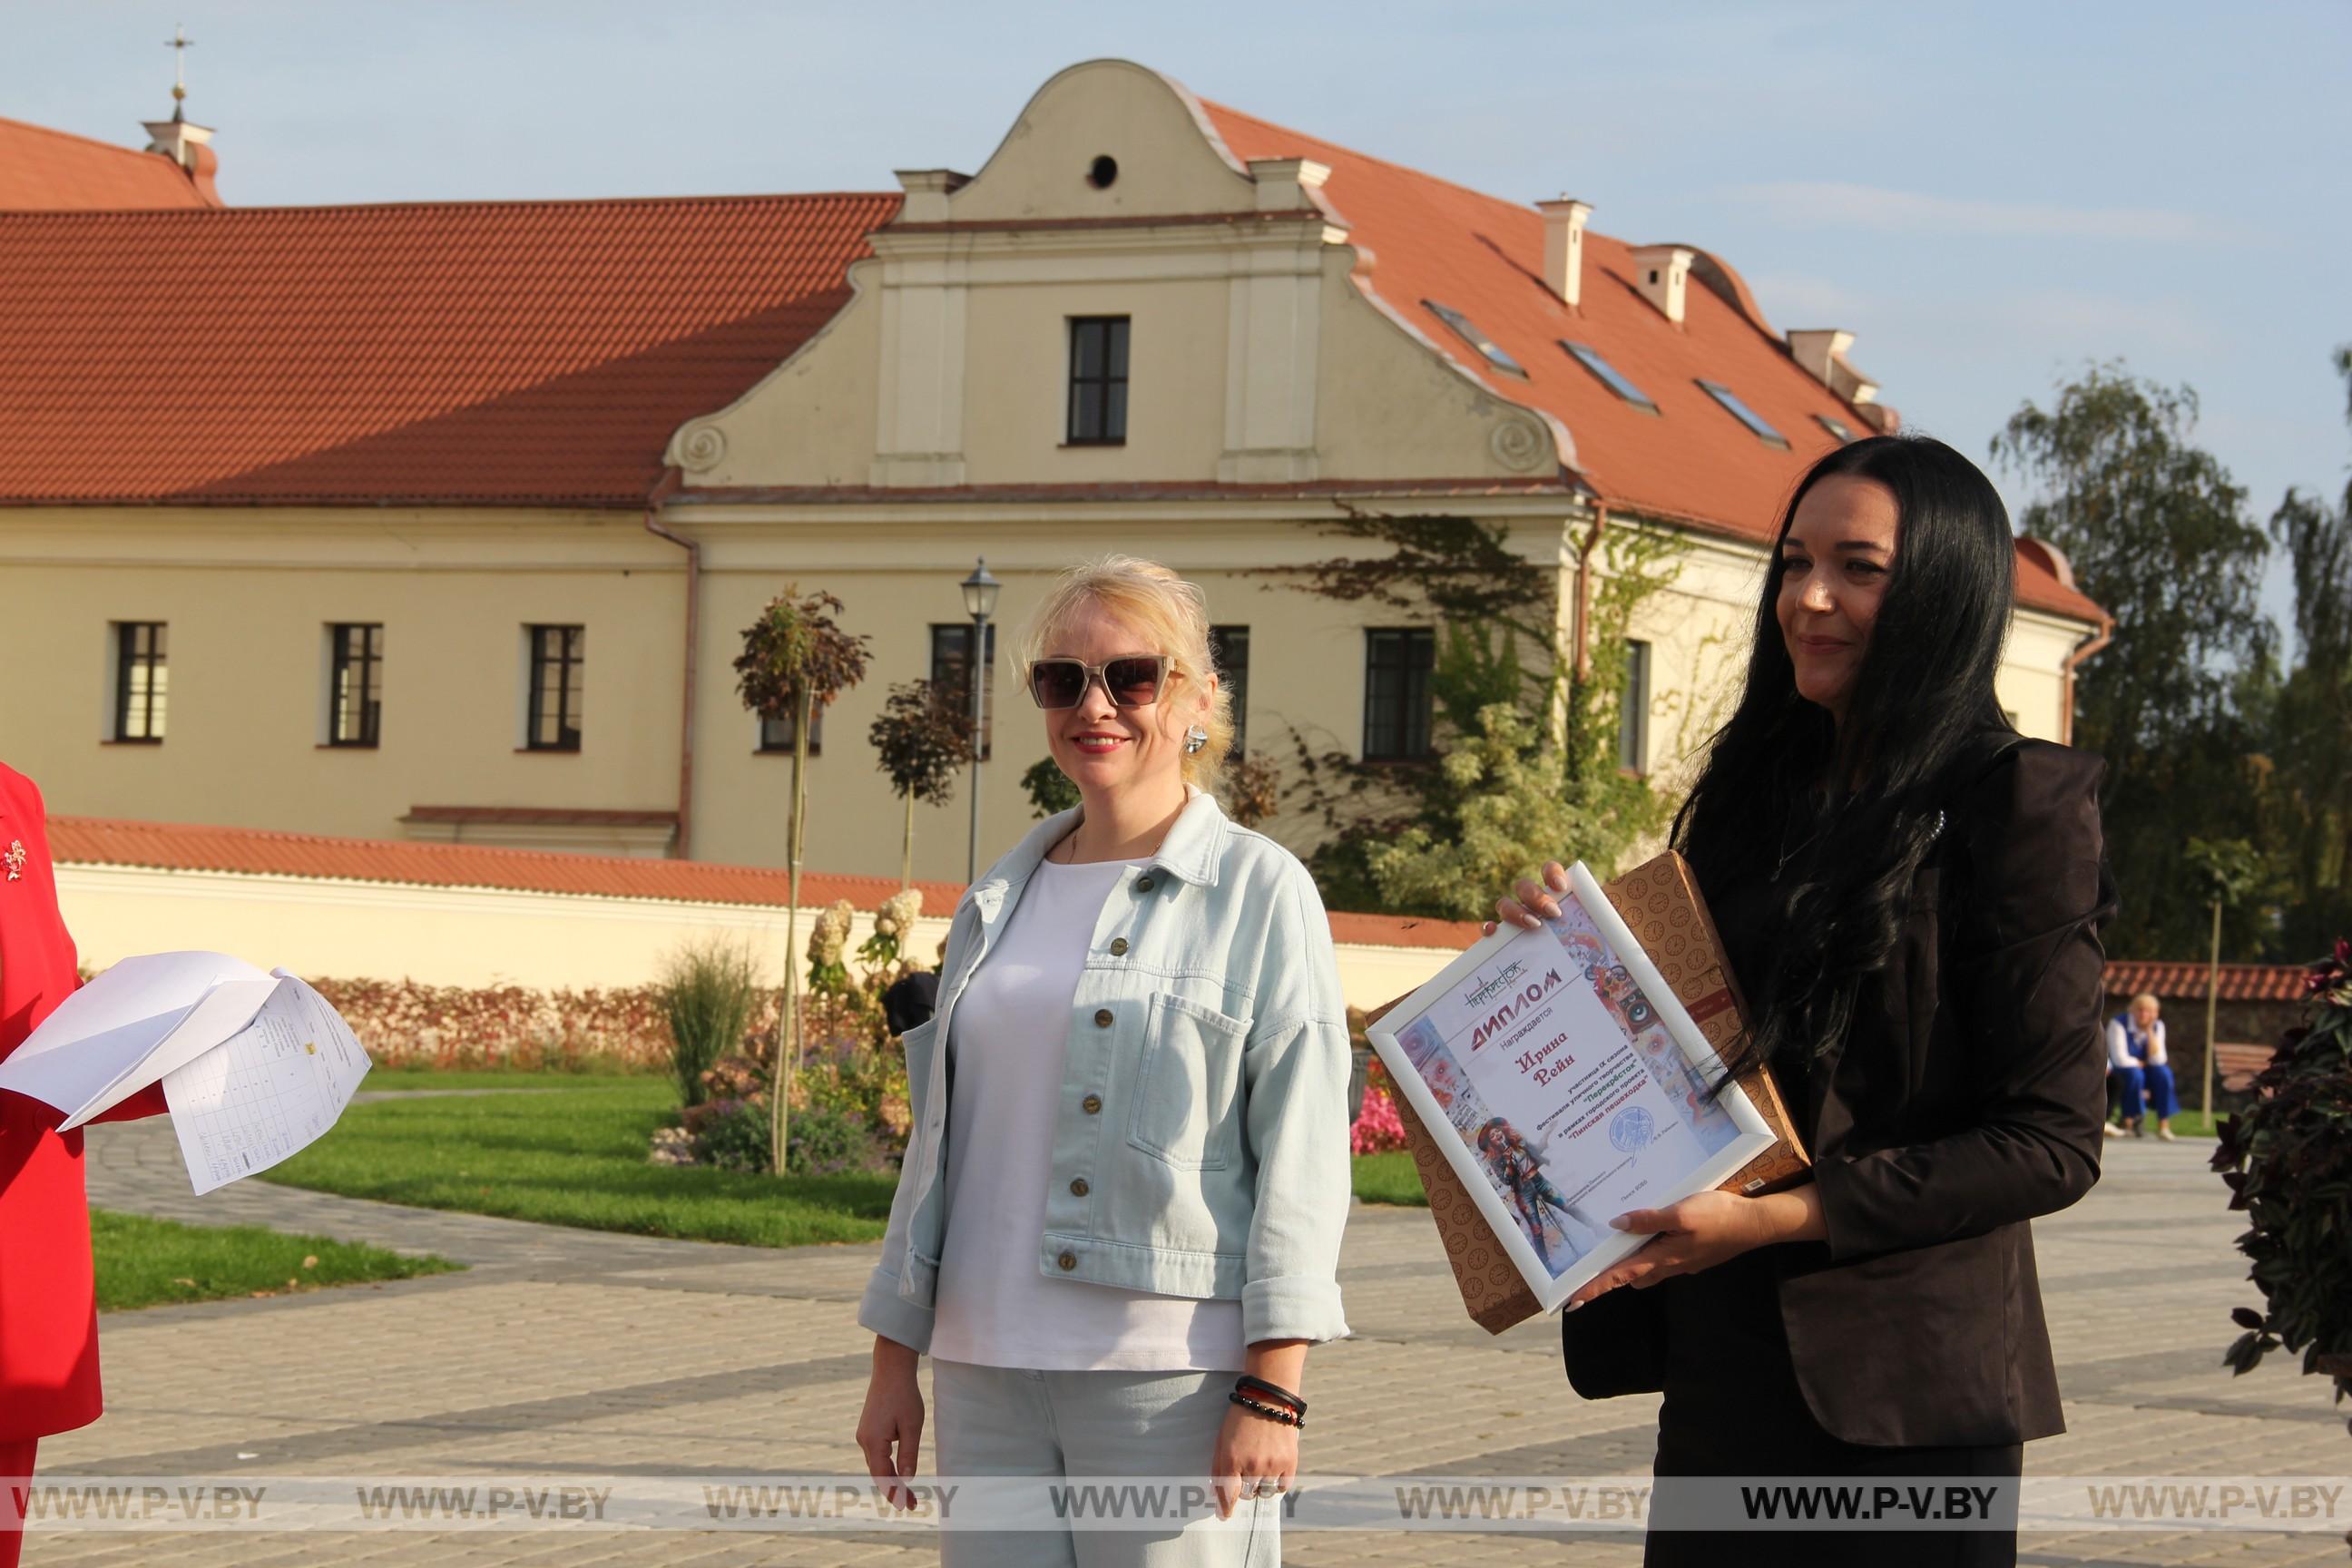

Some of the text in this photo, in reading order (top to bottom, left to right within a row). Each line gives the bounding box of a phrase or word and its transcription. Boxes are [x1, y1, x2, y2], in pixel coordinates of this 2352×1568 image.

[1473, 967, 1562, 1051] ДИПЛОМ
[1499, 1006, 1553, 1050] Награждается
[1514, 1031, 1568, 1073] Ирина
[1534, 1054, 1575, 1087] Рейн
[1567, 1067, 1599, 1094] участница
[1606, 1044, 1628, 1063] сезона
